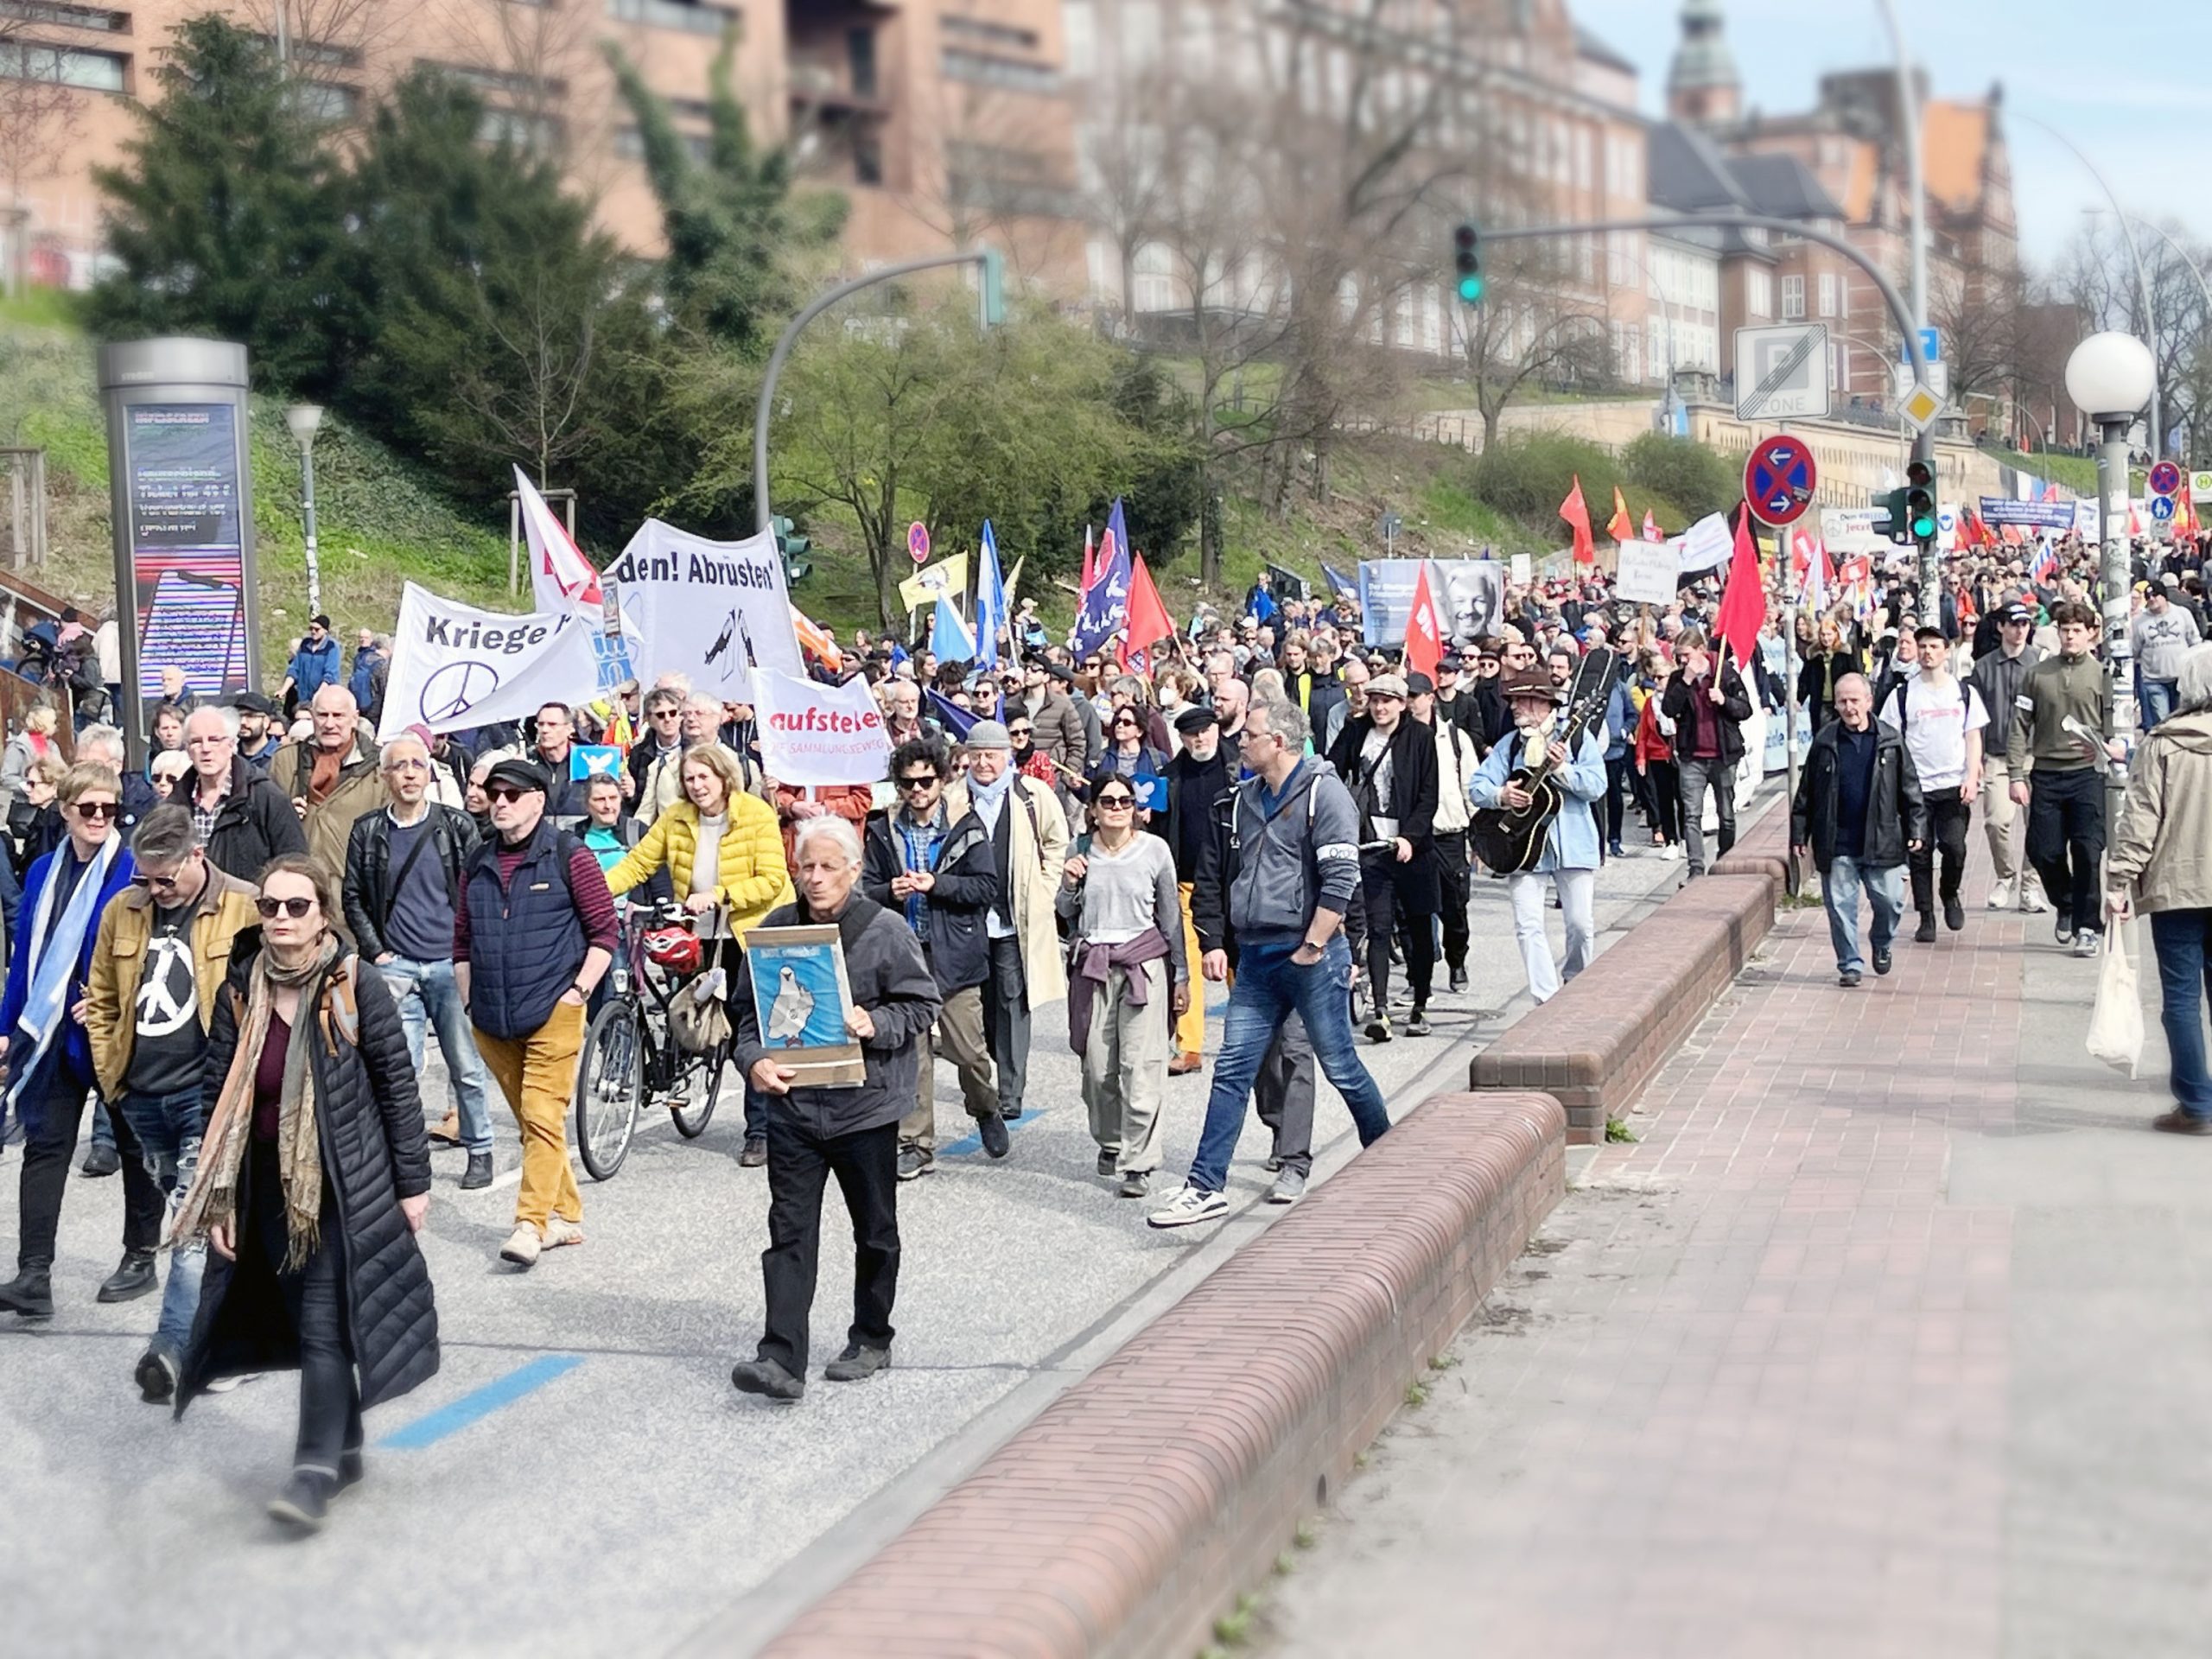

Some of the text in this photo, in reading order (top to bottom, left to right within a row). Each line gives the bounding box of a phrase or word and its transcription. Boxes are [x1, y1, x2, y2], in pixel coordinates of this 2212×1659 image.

[1761, 397, 1805, 413] ZONE
[616, 551, 678, 583] den!
[426, 615, 547, 654] Kriege
